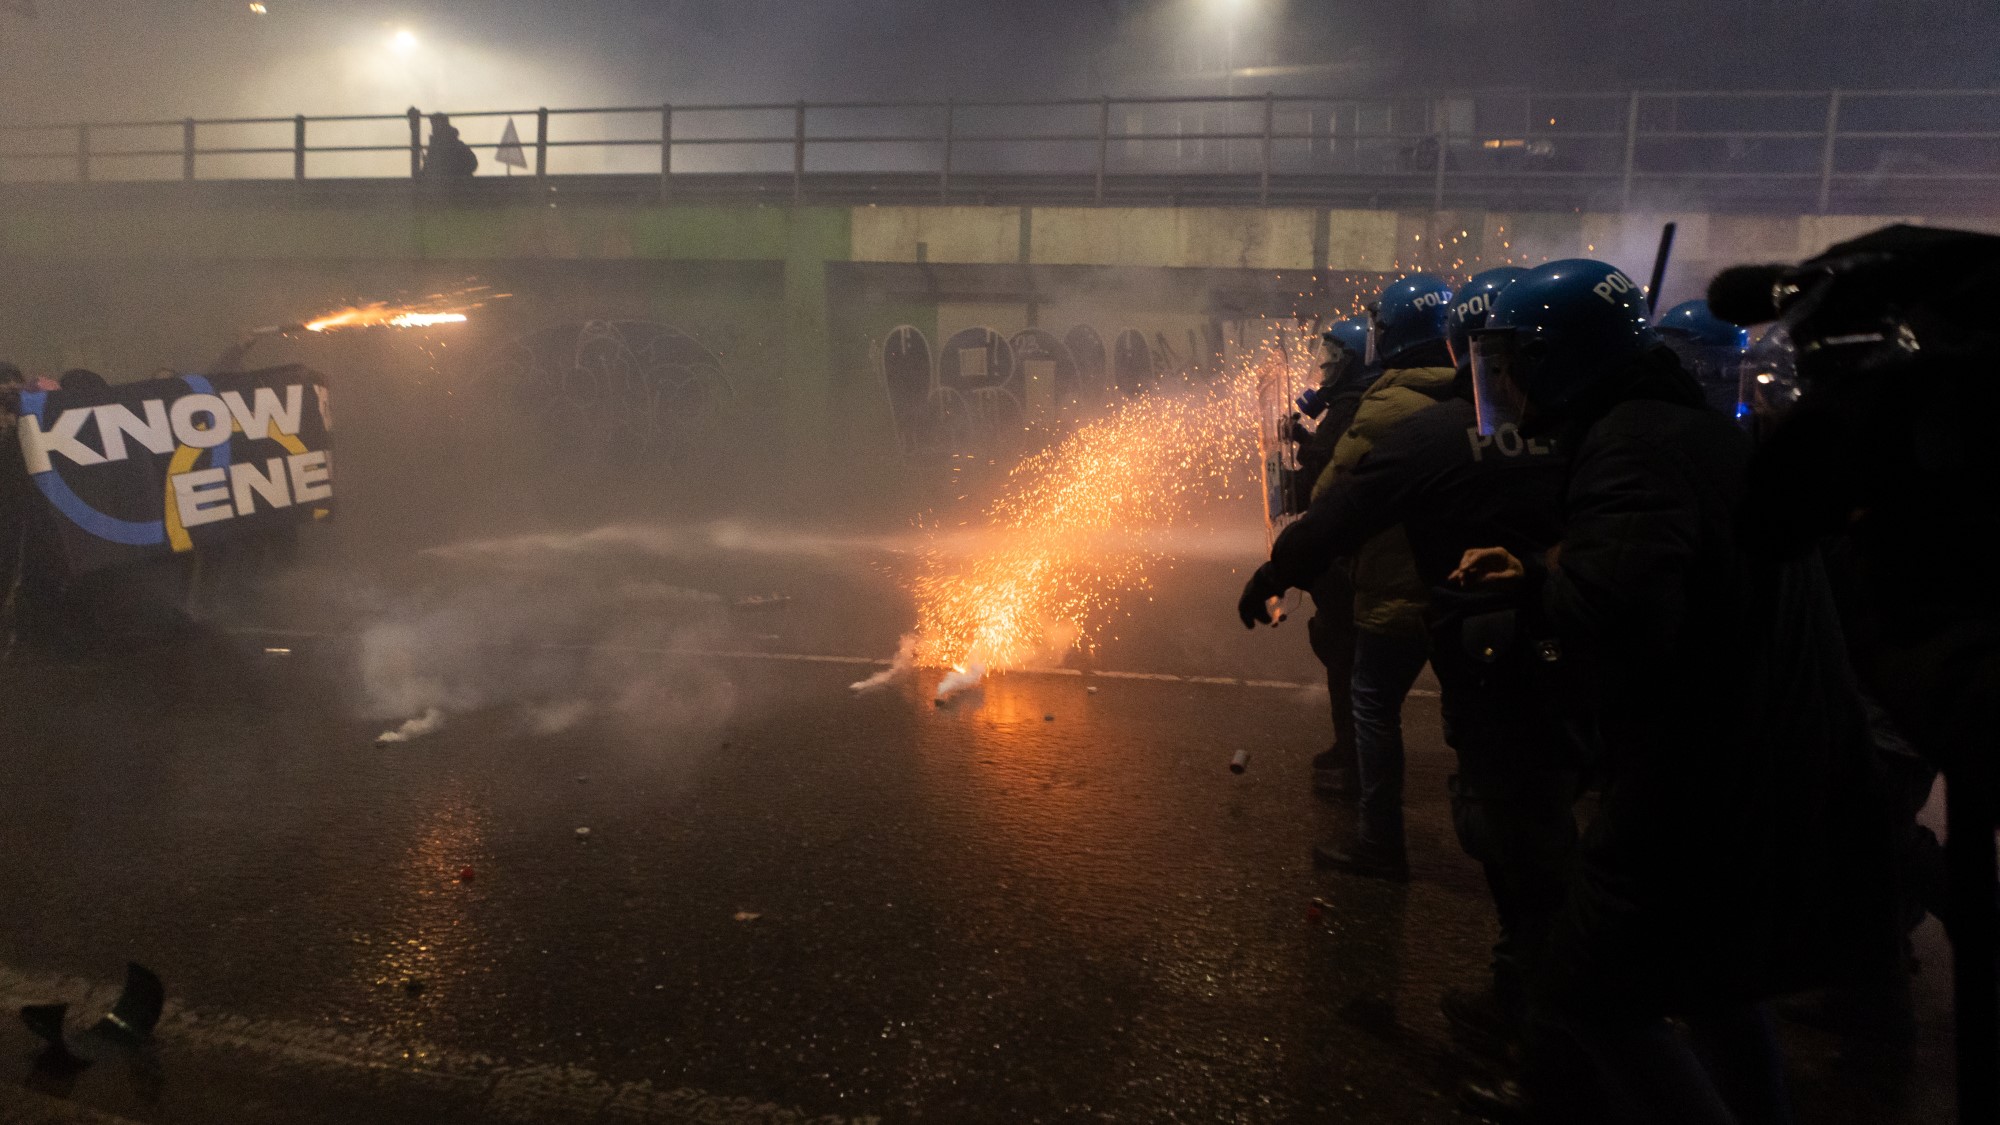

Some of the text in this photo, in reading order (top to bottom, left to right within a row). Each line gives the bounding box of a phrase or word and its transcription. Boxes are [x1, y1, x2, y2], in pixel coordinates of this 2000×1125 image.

[1457, 292, 1500, 323] POL
[18, 384, 303, 475] KNOW
[1466, 422, 1556, 462] POL
[171, 450, 332, 528] ENE
